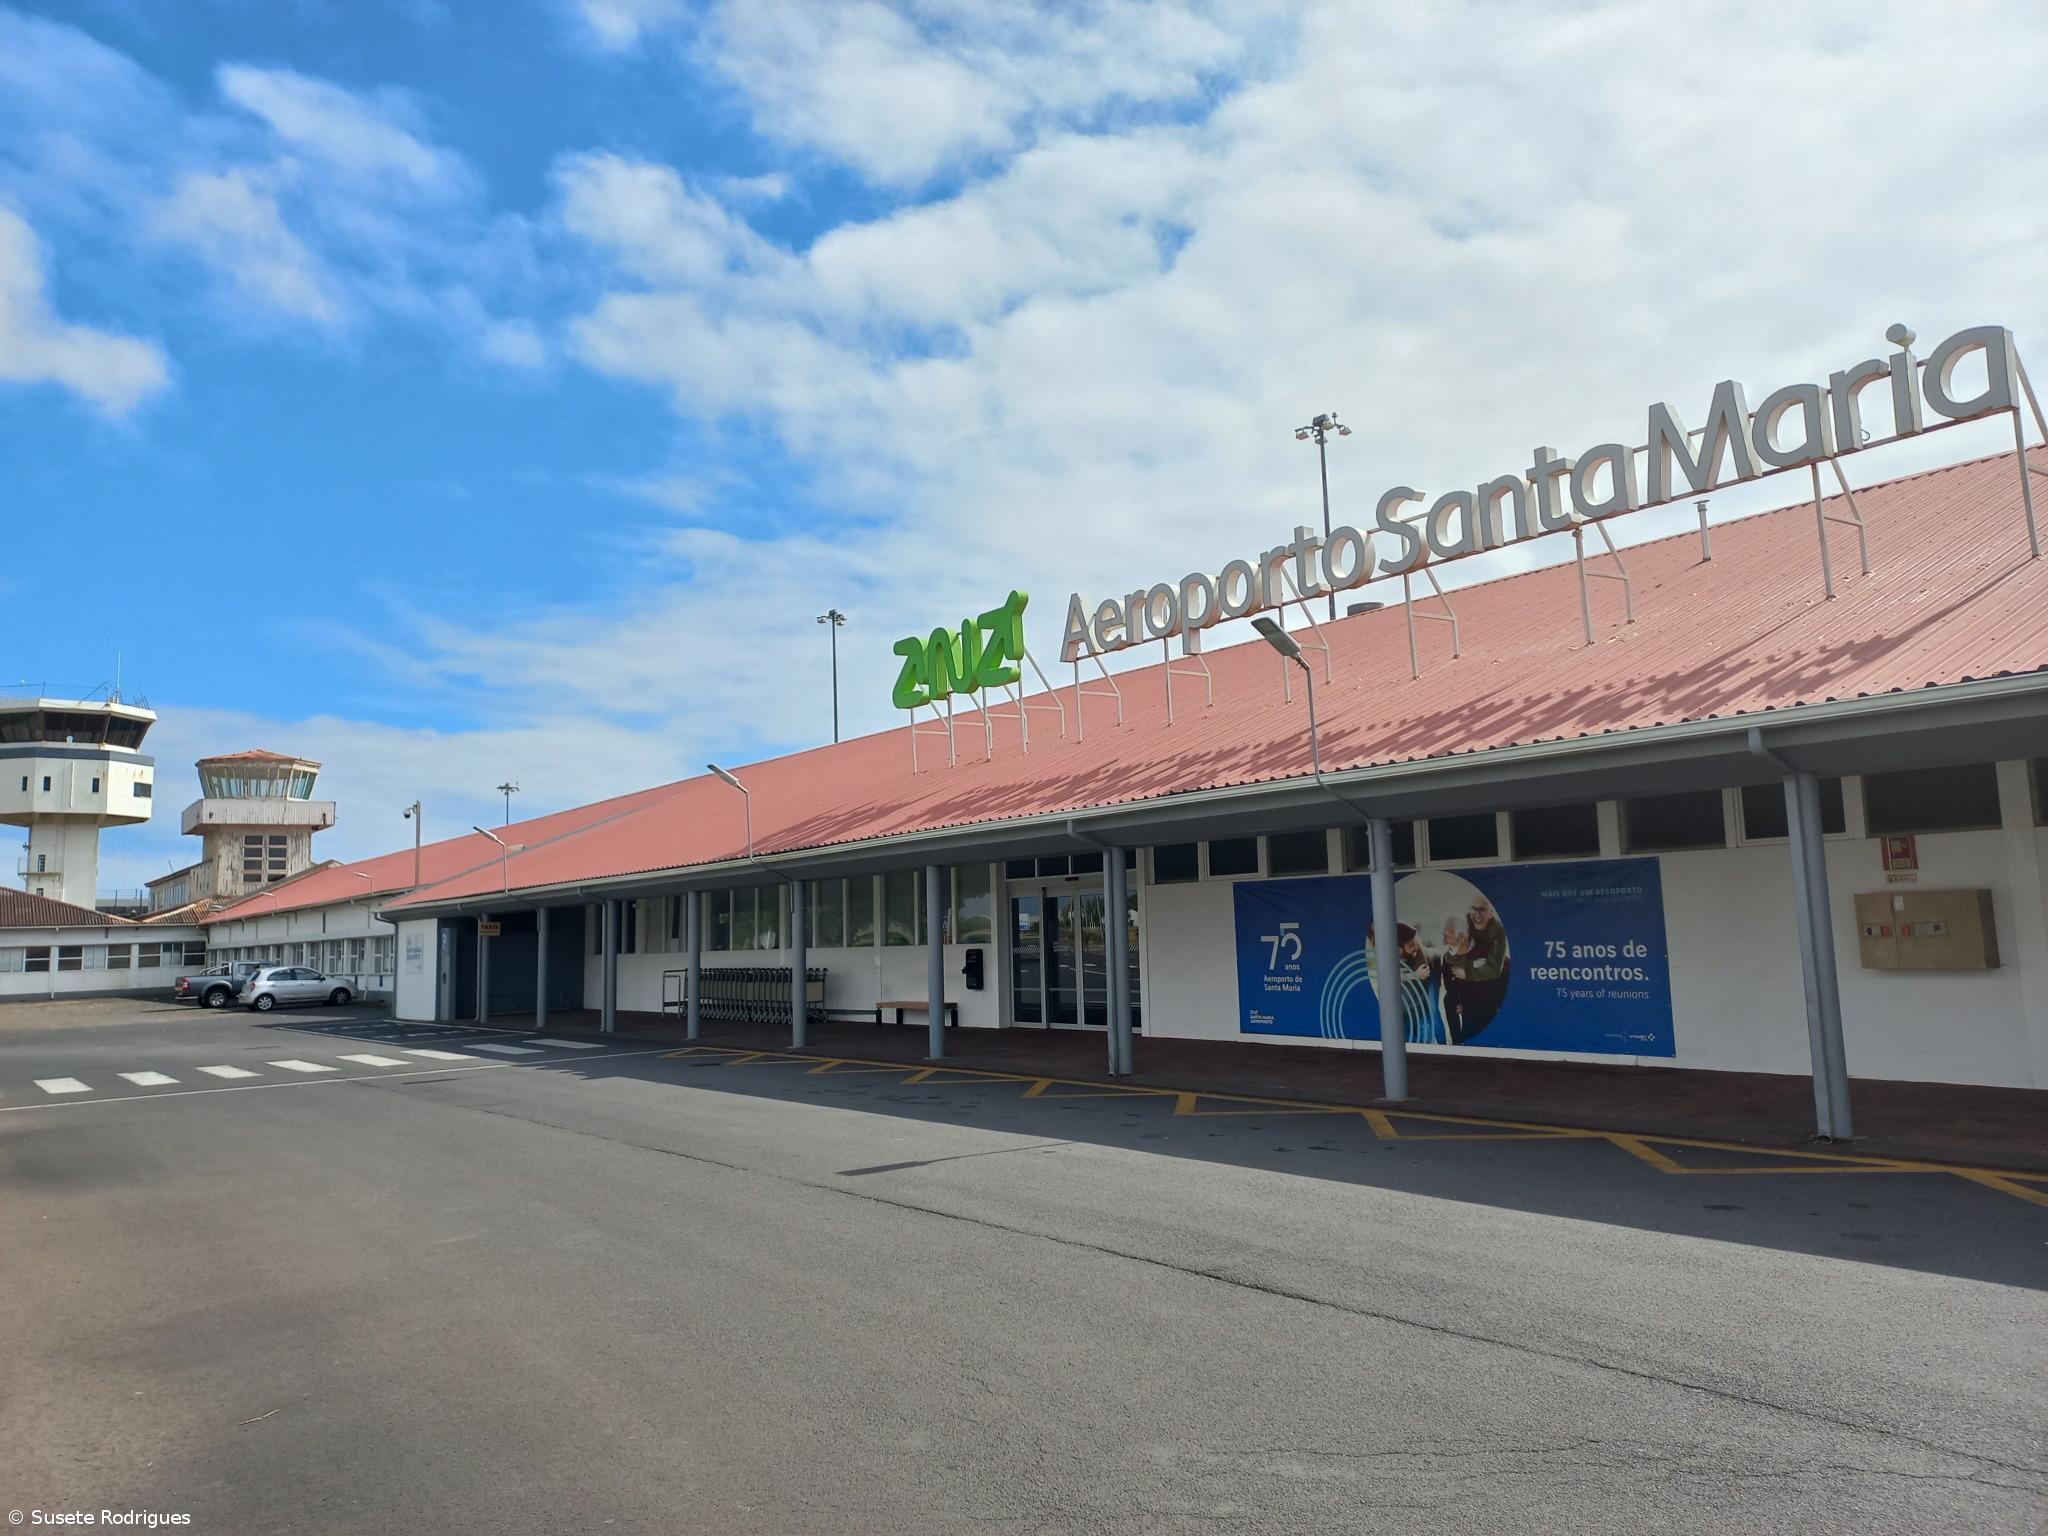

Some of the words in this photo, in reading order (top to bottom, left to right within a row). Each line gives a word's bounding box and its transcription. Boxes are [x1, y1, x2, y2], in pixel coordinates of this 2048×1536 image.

[1260, 922, 1302, 970] 75
[1544, 941, 1567, 958] 75
[1572, 944, 1617, 958] anos
[1622, 939, 1648, 958] de
[1263, 975, 1293, 984] Aeroporto
[1294, 975, 1303, 983] de
[1530, 965, 1649, 981] reencontros.
[1556, 987, 1568, 998] 75
[1570, 989, 1594, 1000] years
[1595, 987, 1606, 998] of
[1608, 989, 1650, 999] reunions
